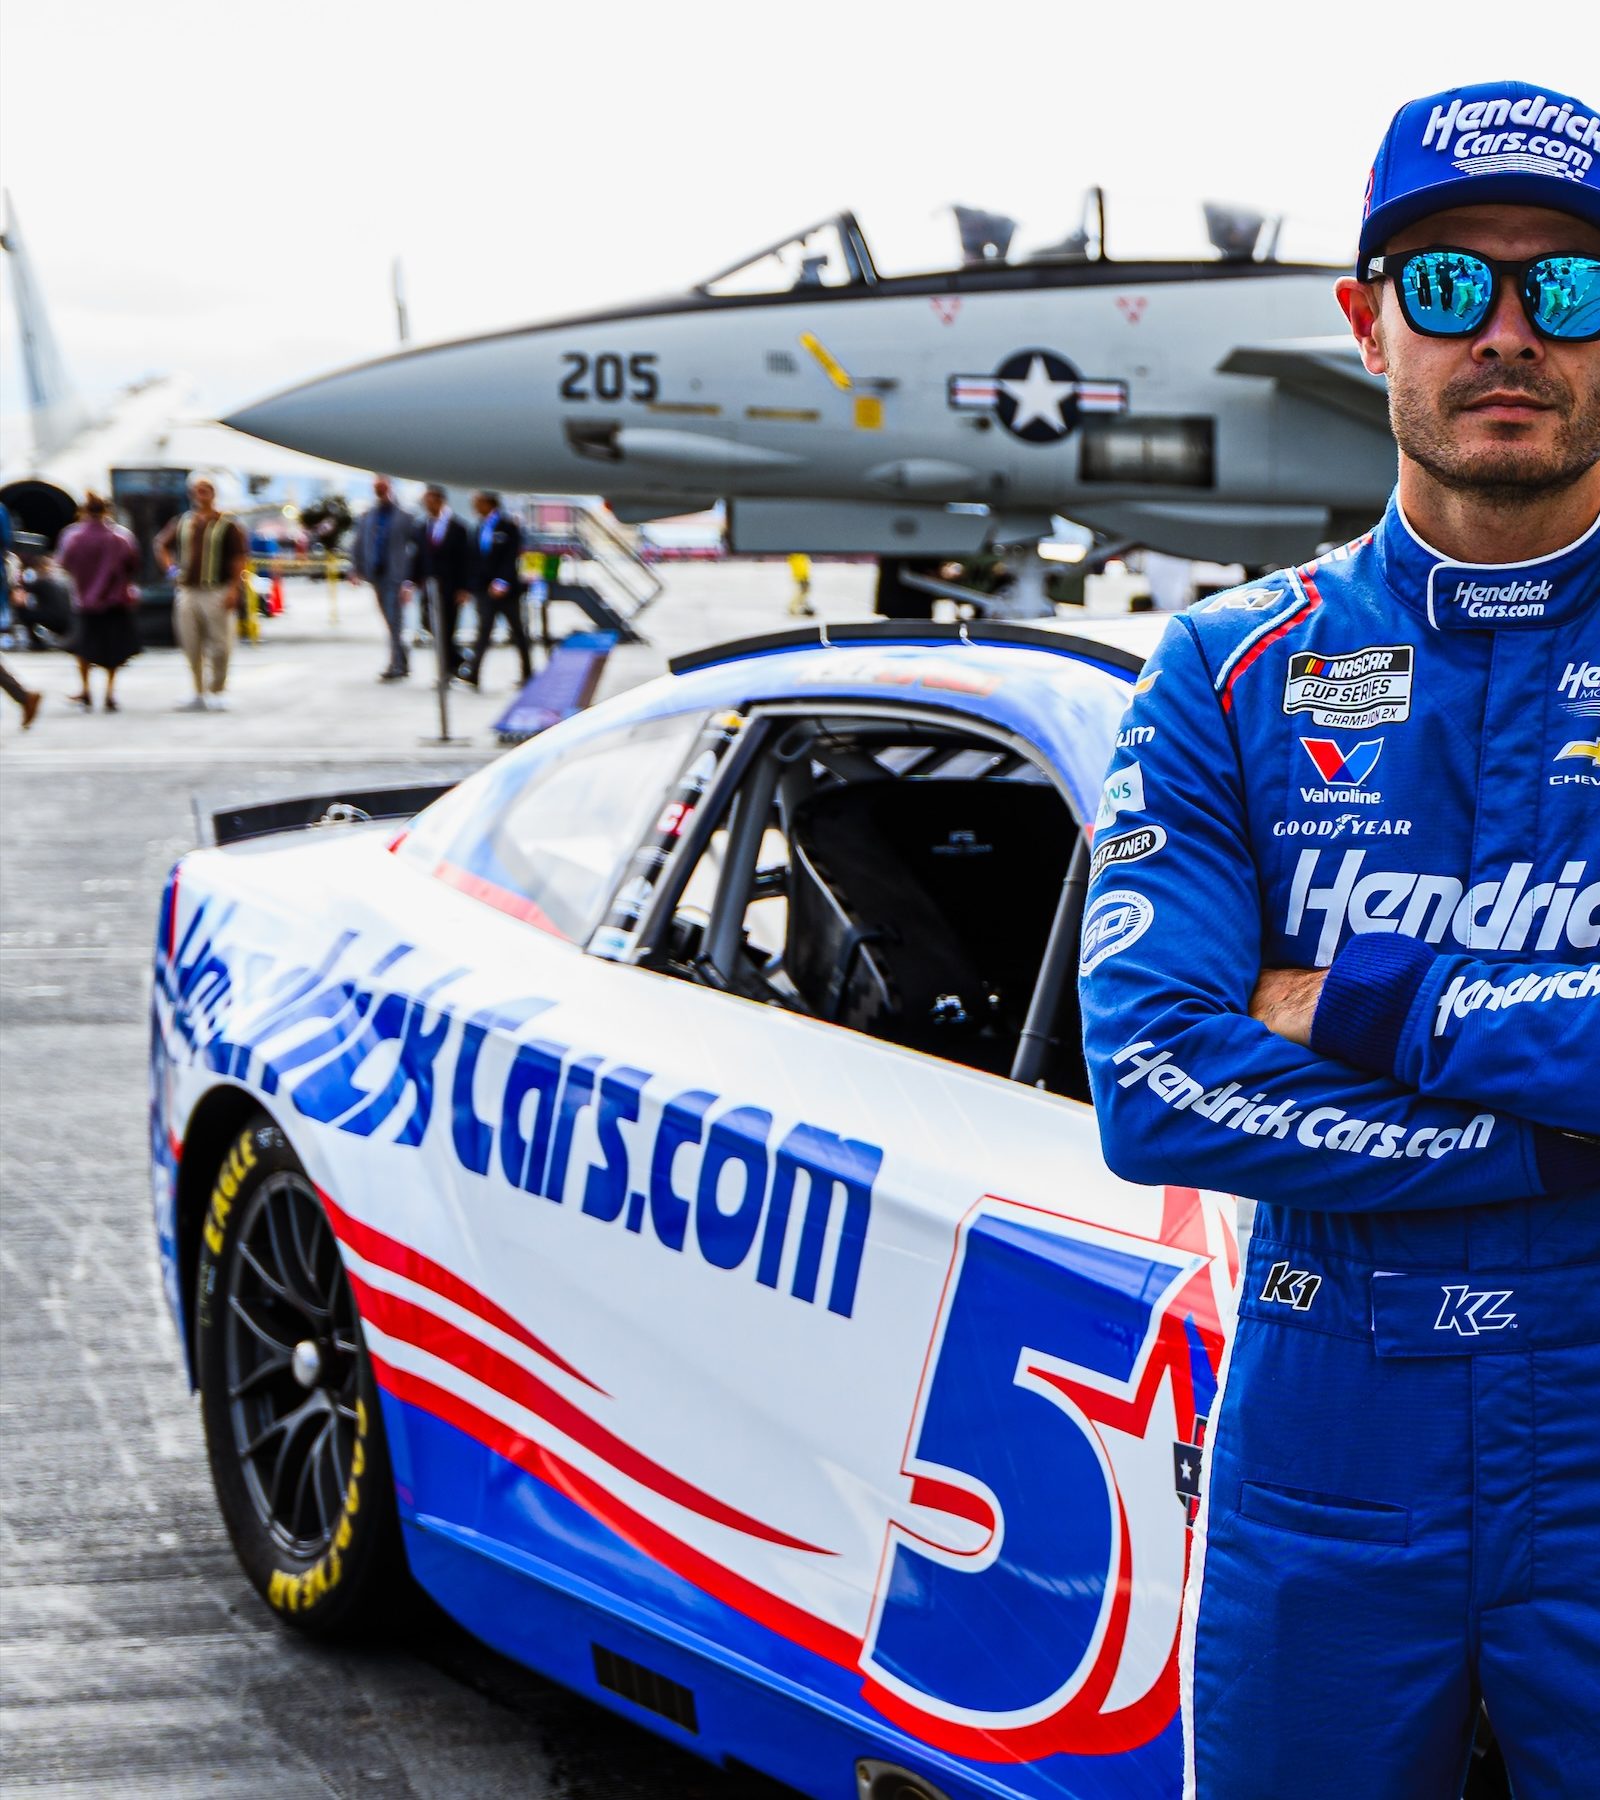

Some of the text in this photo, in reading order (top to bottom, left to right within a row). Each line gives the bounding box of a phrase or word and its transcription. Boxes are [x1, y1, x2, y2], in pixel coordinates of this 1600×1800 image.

[1453, 131, 1593, 171] Cars.com
[559, 352, 660, 401] 205
[1454, 580, 1552, 608] Hendrick
[1468, 602, 1545, 618] Cars.com
[1328, 652, 1393, 679] NASCAR
[1301, 679, 1392, 703] CUP SERIES
[1323, 708, 1398, 727] CHAMPION 2X
[1300, 787, 1381, 804] Valvoline
[1273, 816, 1412, 838] GOODYEAR
[204, 1128, 258, 1255] EAGLE
[1260, 1261, 1322, 1311] K1
[858, 1195, 1212, 1730] 5
